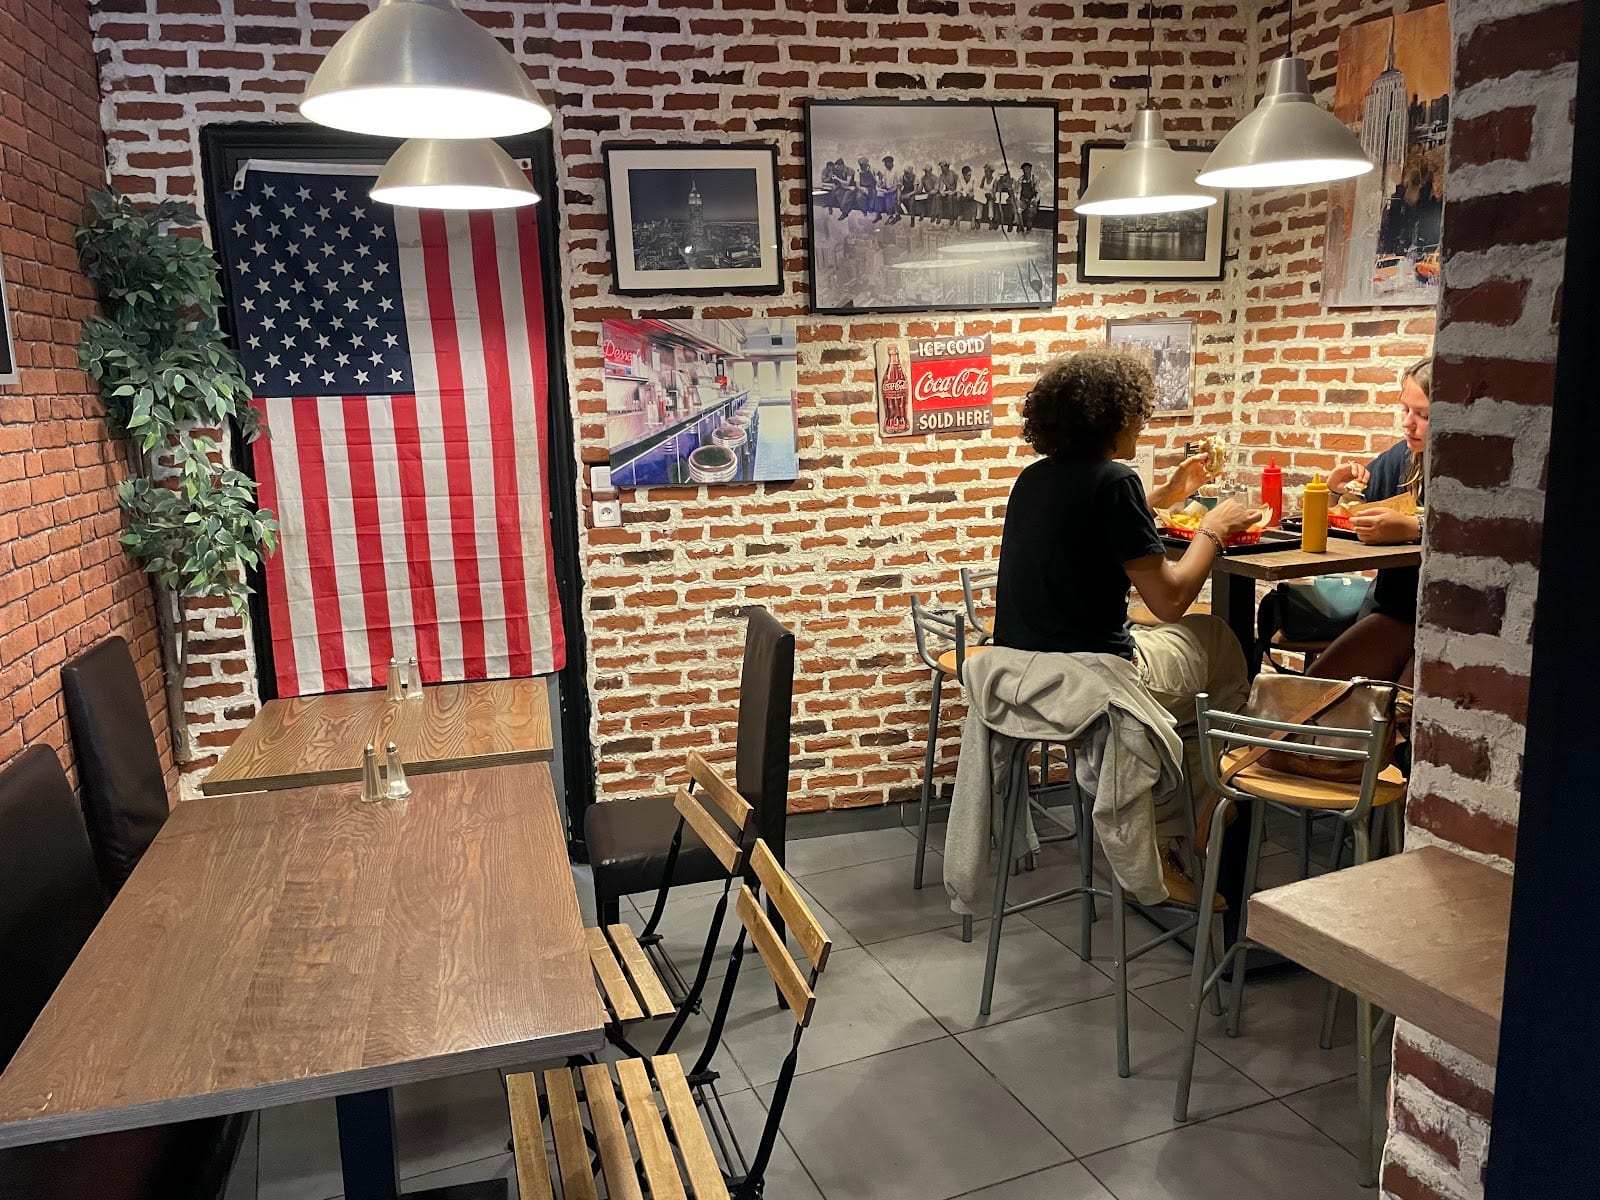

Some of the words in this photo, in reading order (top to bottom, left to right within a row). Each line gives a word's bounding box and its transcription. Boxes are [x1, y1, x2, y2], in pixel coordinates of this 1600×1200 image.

[603, 339, 640, 361] Desse
[918, 341, 944, 357] ICE
[946, 338, 985, 355] COLD
[919, 412, 953, 430] SOLD
[956, 409, 990, 427] HERE
